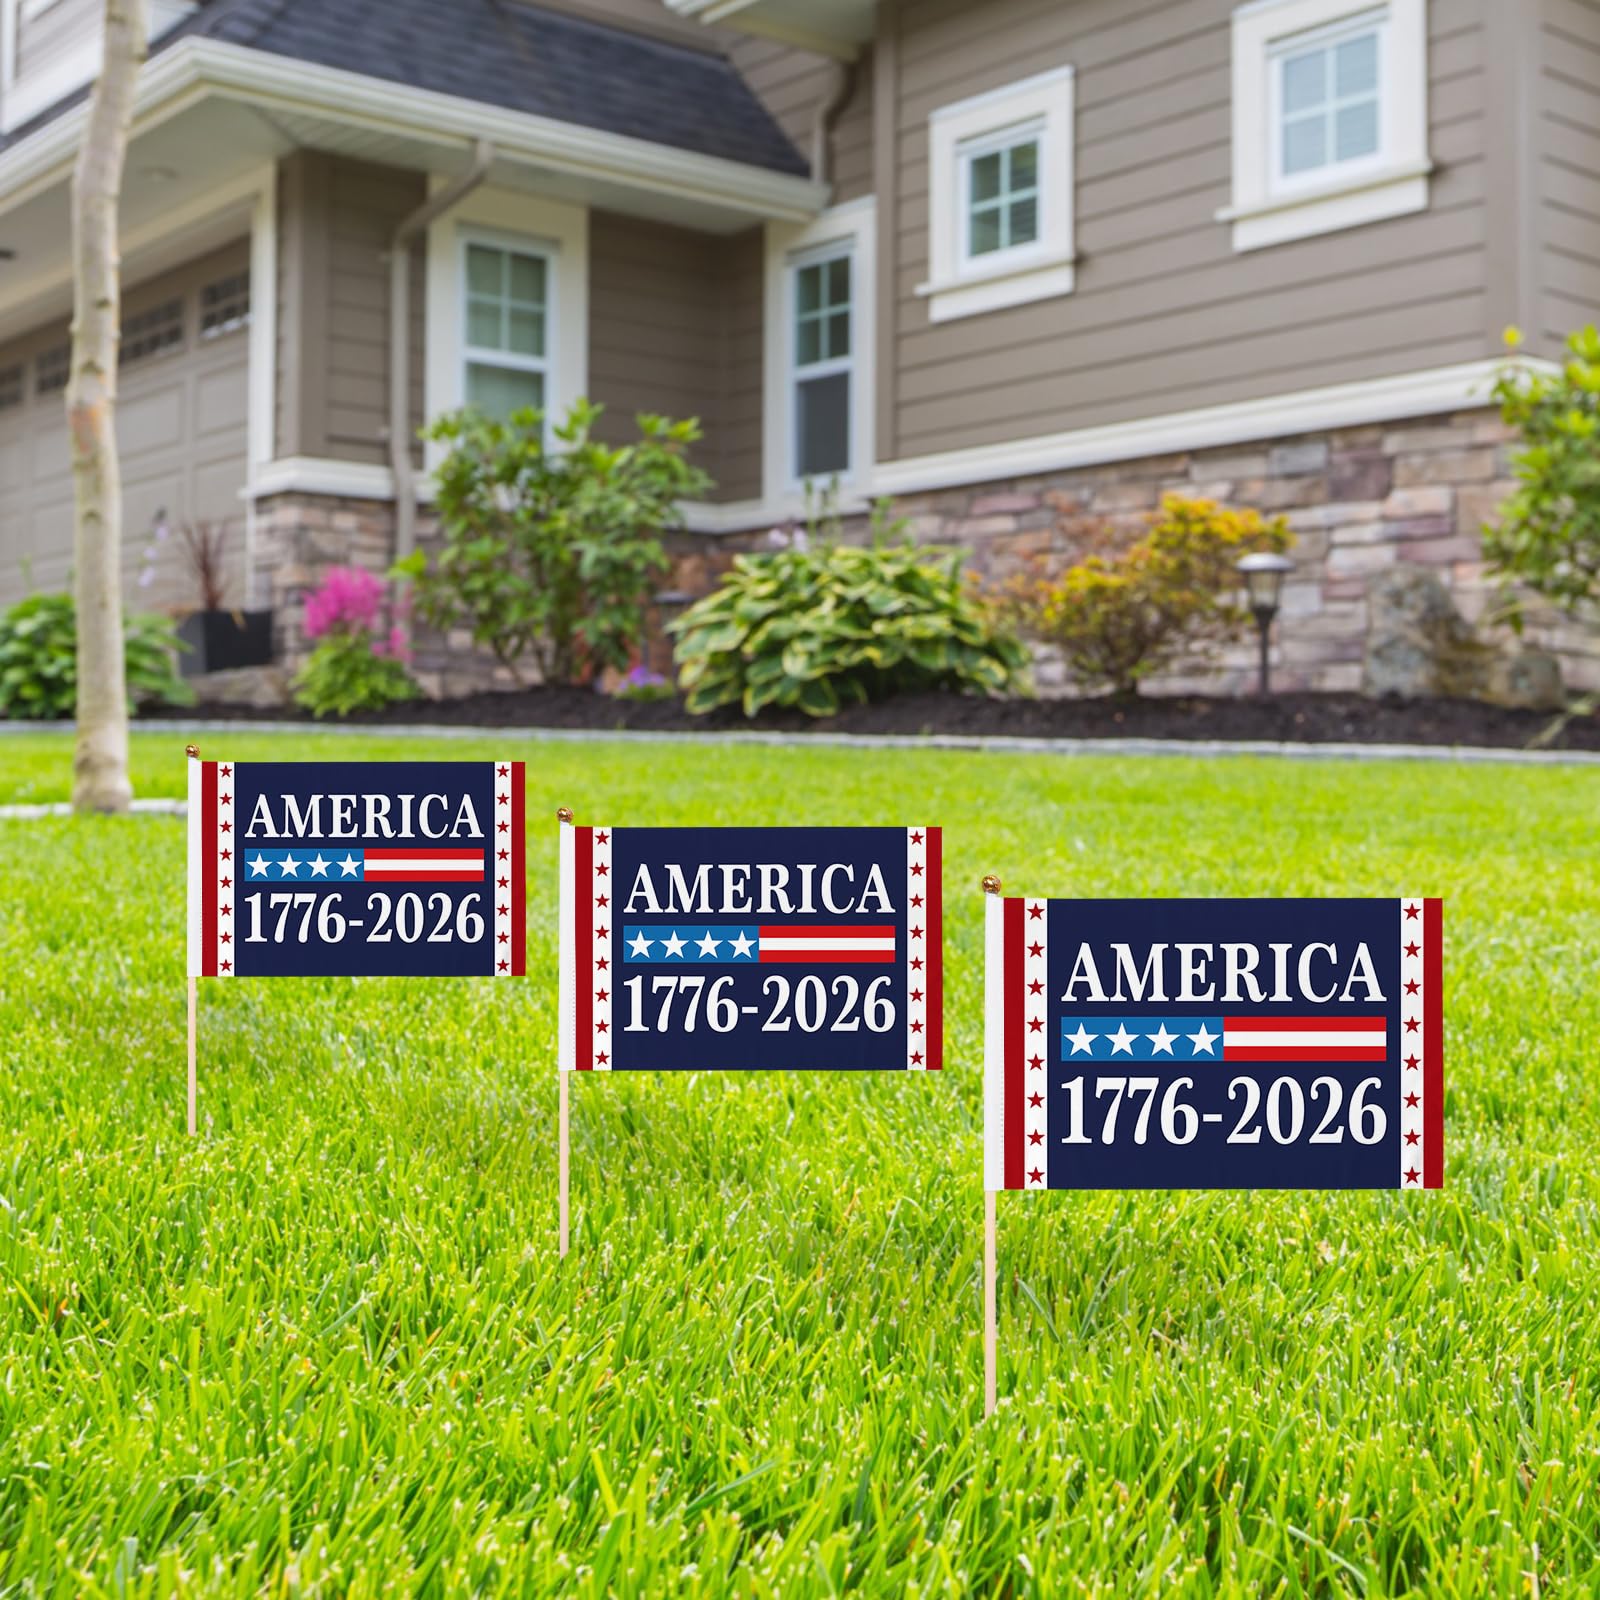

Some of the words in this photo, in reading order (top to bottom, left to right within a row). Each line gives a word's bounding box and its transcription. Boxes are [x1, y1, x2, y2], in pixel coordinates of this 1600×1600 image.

[244, 793, 485, 839] AMERICA
[623, 863, 896, 914] AMERICA
[244, 892, 485, 943] 1776-2026
[1061, 942, 1387, 1003] AMERICA
[623, 974, 896, 1033] 1776-2026
[1061, 1075, 1387, 1145] 1776-2026
